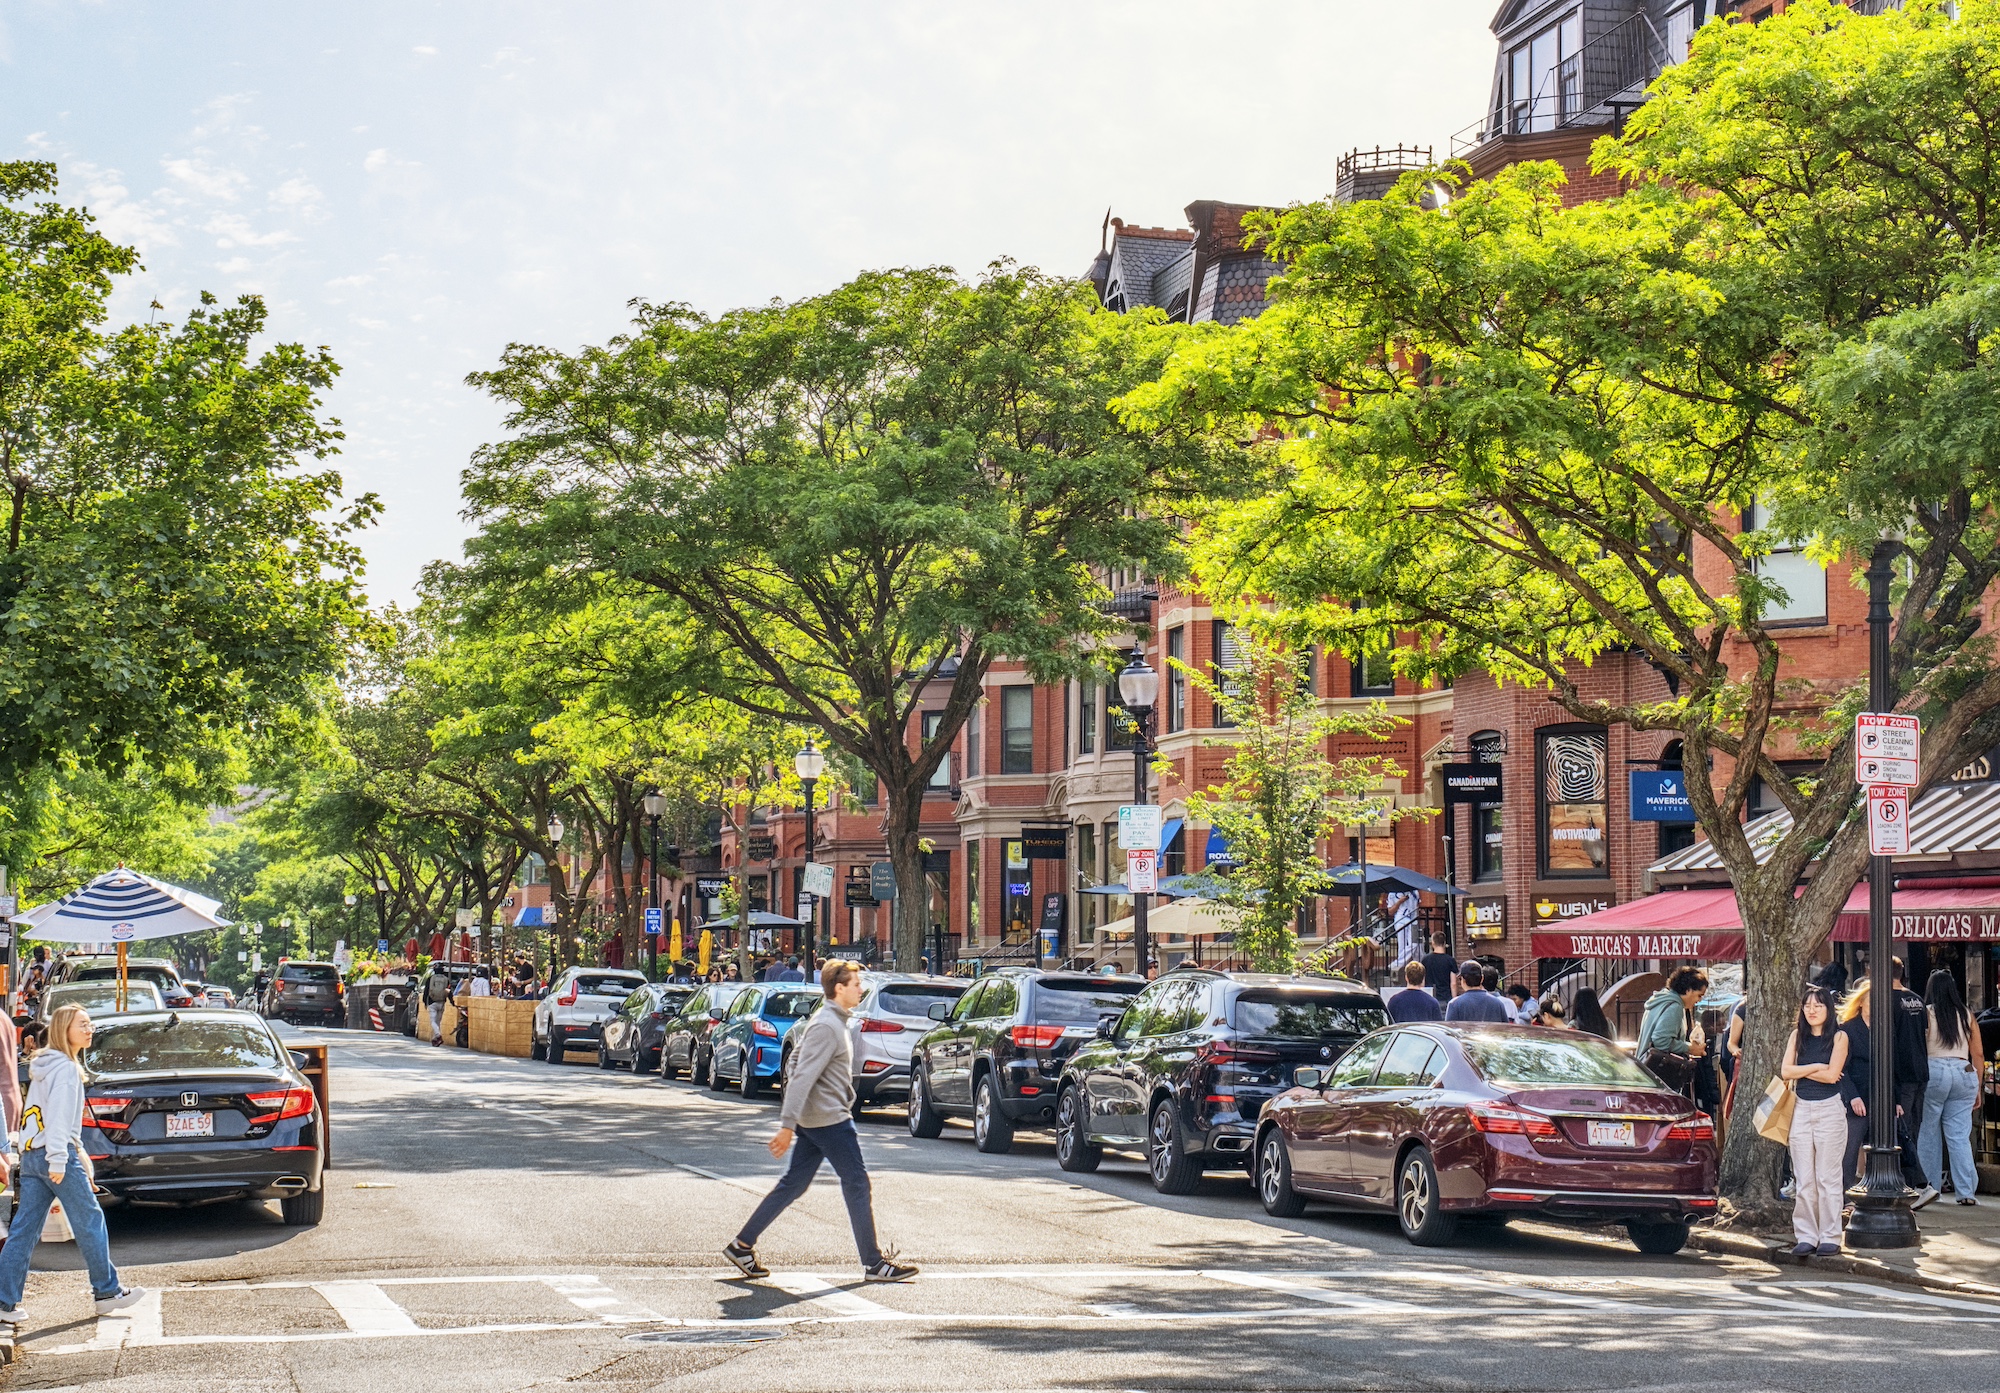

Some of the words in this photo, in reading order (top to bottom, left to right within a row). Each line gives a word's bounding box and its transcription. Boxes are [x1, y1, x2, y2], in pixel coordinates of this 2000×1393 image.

[1862, 716, 1887, 726] TOW
[1890, 717, 1915, 728] ZONE
[1882, 729, 1907, 738] STREET
[1882, 737, 1914, 746] CLEANING
[1448, 776, 1480, 786] CANADIAN
[1481, 777, 1498, 786] PARK
[1870, 788, 1885, 797] TOW
[1887, 788, 1906, 797] ZONE
[1646, 797, 1689, 805] MAVERICK
[1121, 808, 1130, 817] 2
[1553, 829, 1601, 841] MOTIVATION
[1891, 912, 1972, 938] DELUCA'S
[1571, 935, 1631, 956] DELUCA'S
[1638, 935, 1701, 956] MARKET
[167, 1116, 195, 1131] 3ZAE
[197, 1116, 212, 1130] 59
[1591, 1127, 1610, 1141] 4TT
[1613, 1127, 1632, 1141] 427
